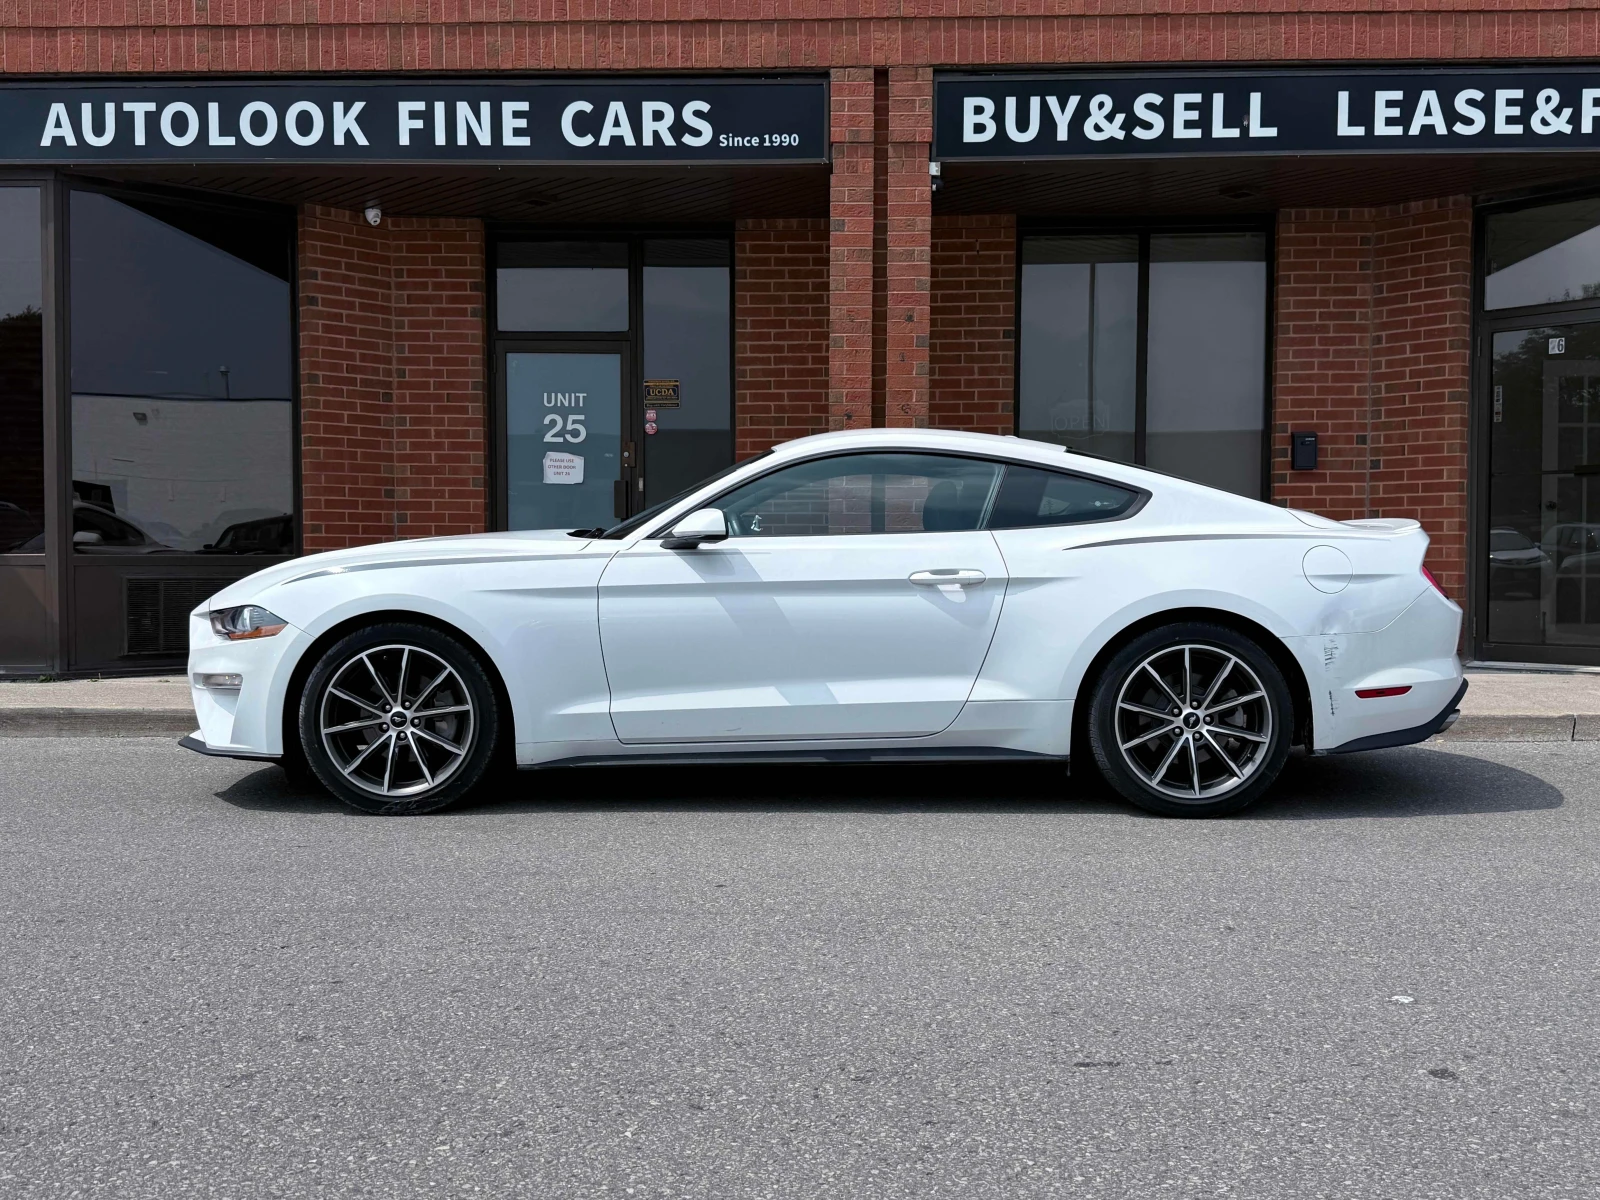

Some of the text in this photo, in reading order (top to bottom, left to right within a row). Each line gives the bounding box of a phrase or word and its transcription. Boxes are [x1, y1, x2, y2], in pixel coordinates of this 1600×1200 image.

[39, 100, 714, 147] AUTOLOOK FINE CARS
[962, 91, 1278, 143] BUY&SELL
[719, 133, 800, 147] Since 1990
[543, 392, 587, 407] UNIT
[650, 388, 675, 396] UCDA
[543, 413, 587, 444] 25
[1054, 414, 1105, 431] OPEN
